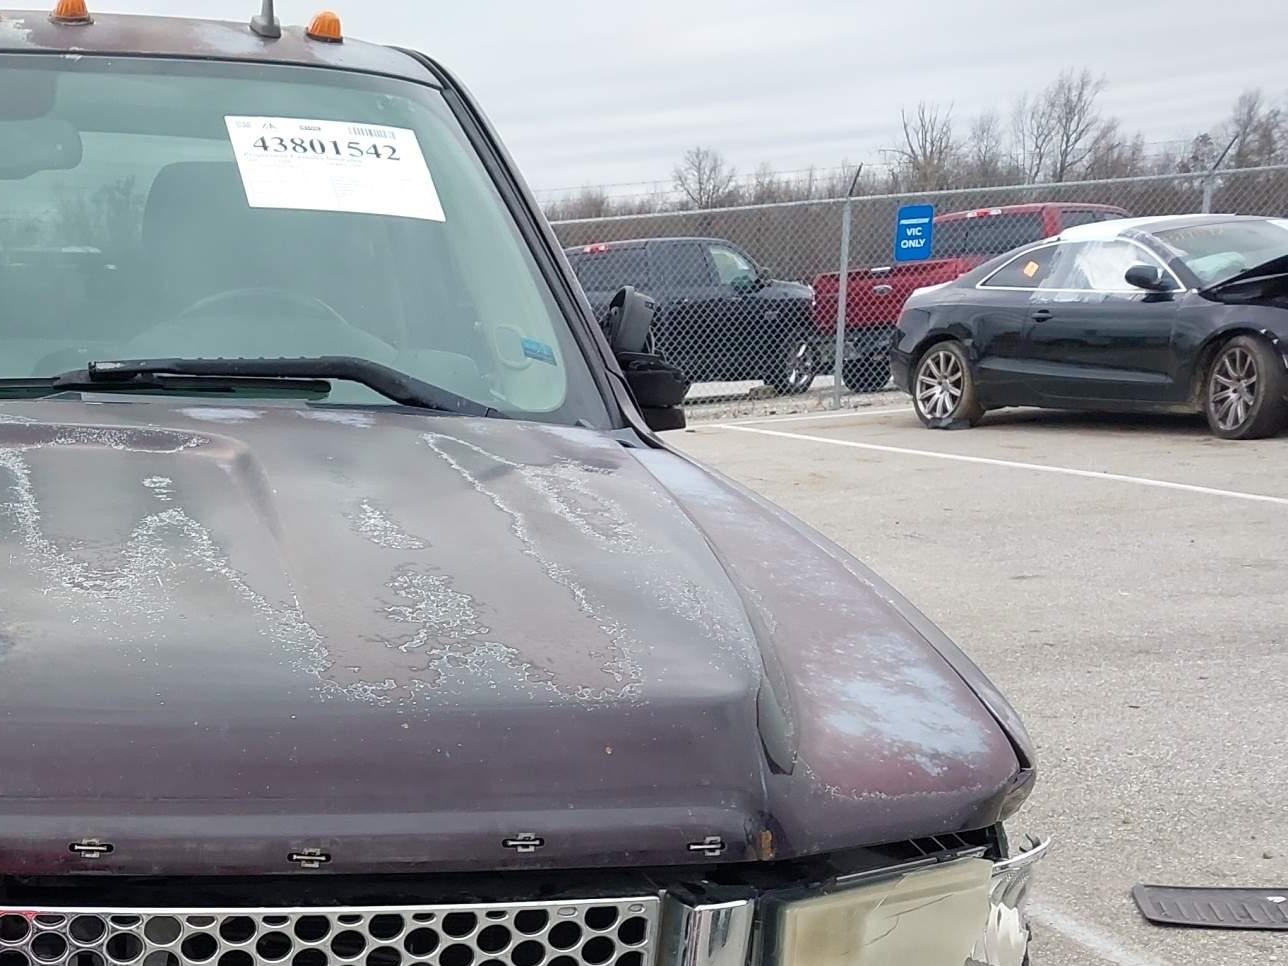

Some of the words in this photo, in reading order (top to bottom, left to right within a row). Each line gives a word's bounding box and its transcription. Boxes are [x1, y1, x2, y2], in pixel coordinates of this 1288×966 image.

[253, 136, 400, 161] 43801542
[906, 227, 922, 236] VIC
[900, 238, 926, 249] ONLY
